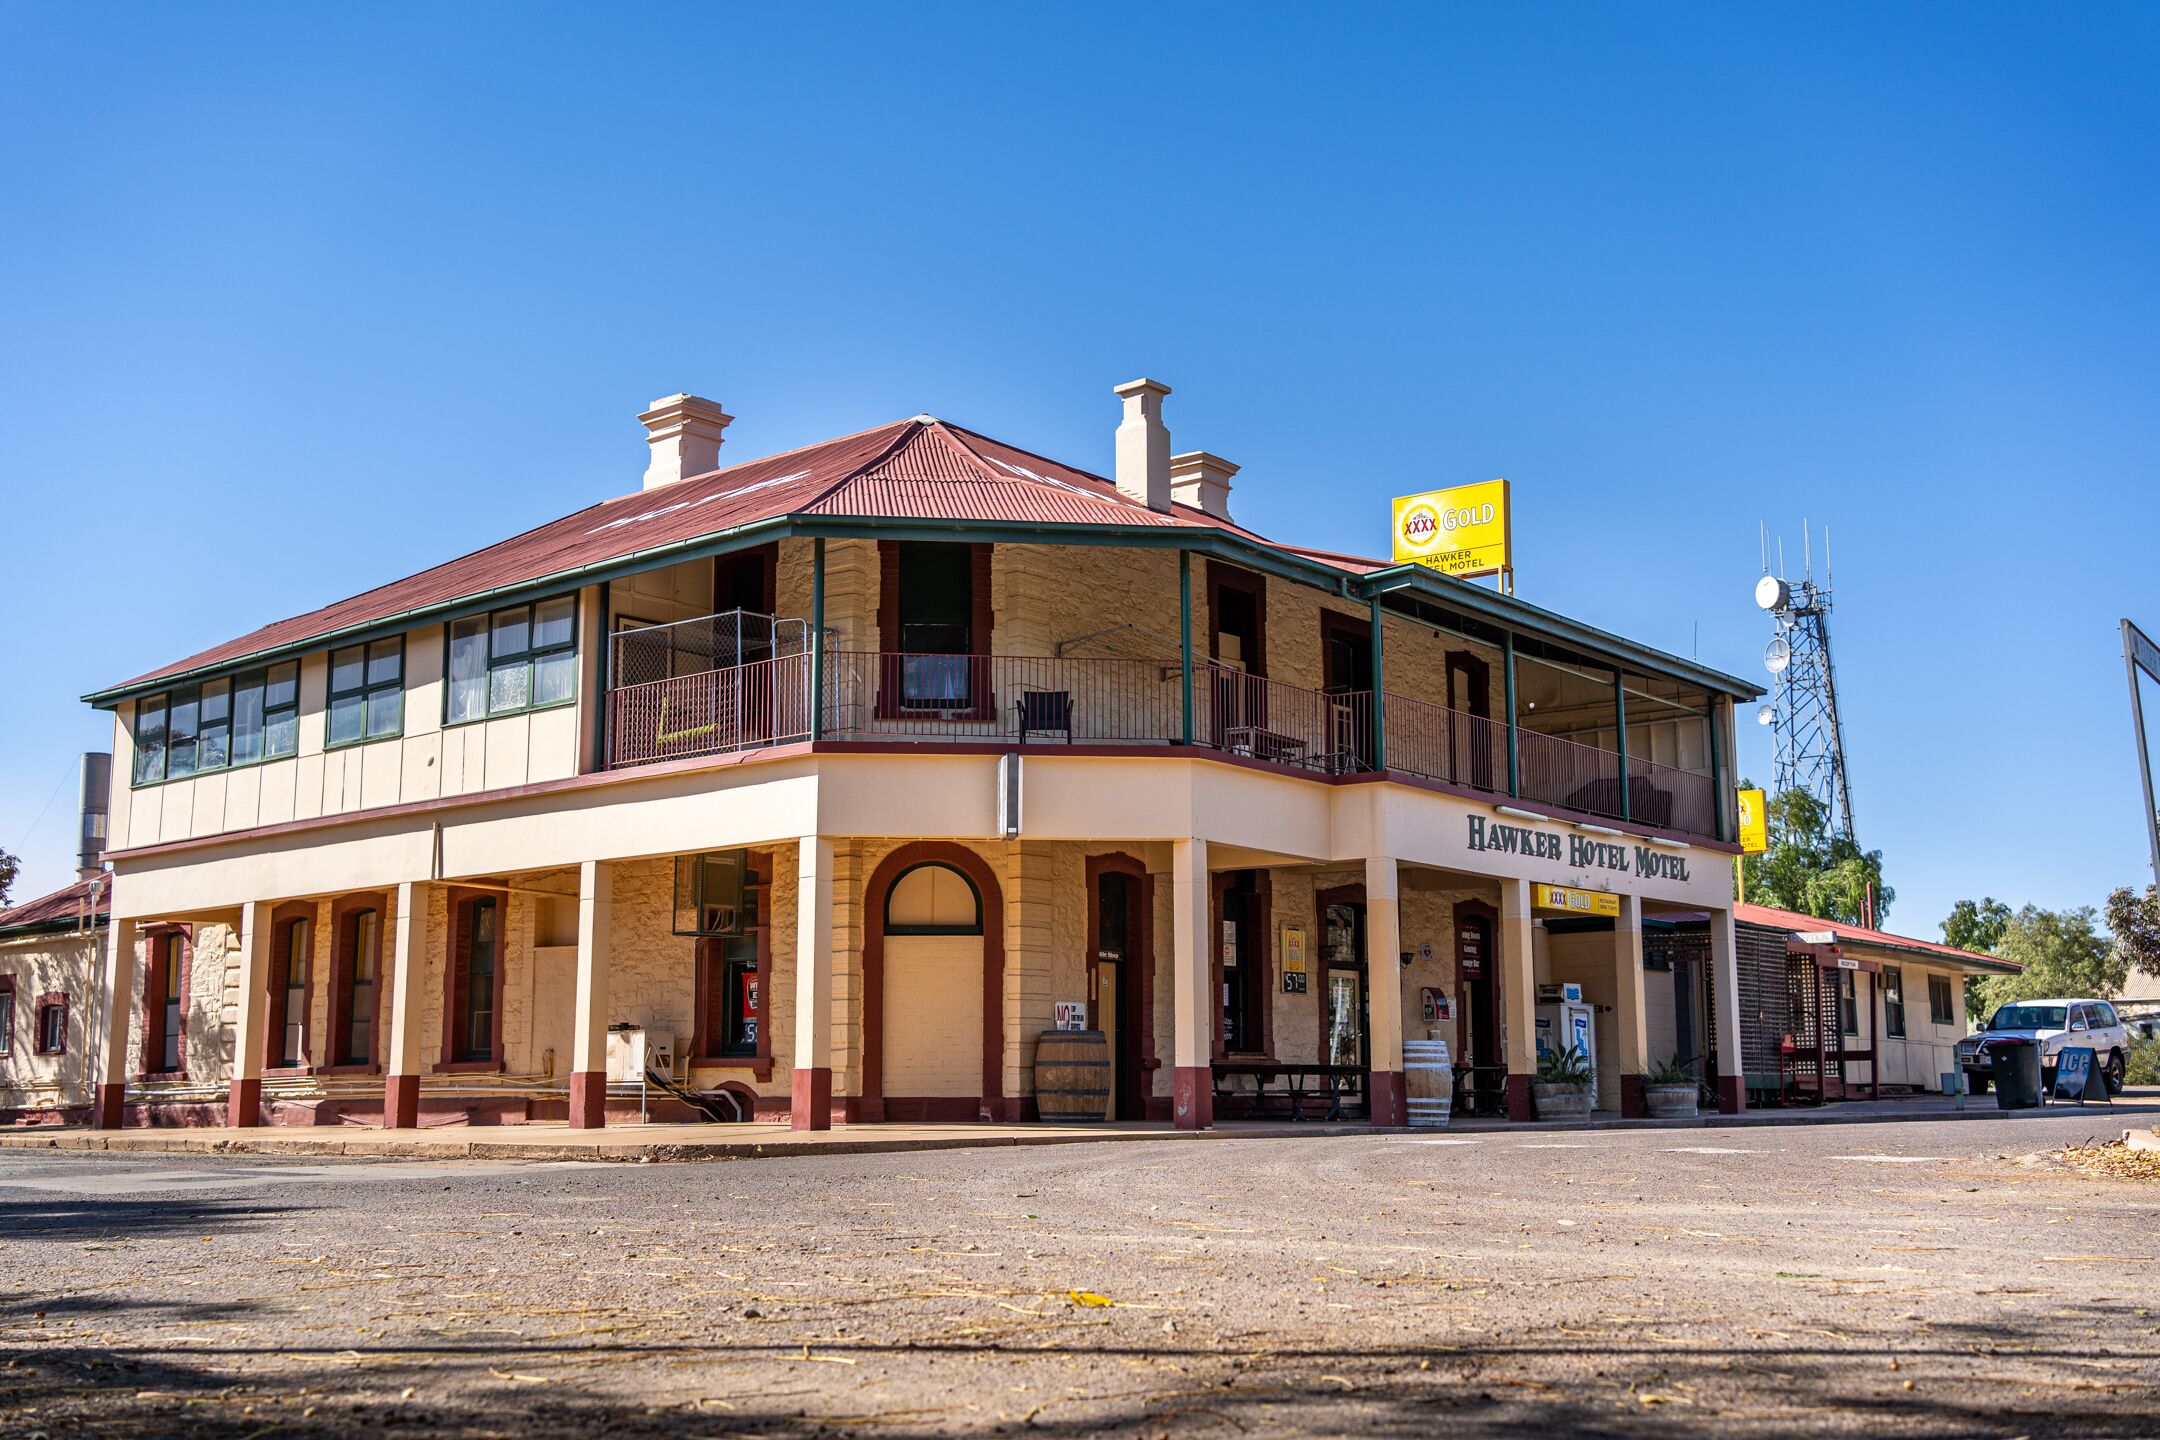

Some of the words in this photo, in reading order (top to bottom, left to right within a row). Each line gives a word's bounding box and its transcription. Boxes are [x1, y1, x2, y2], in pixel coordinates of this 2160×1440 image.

[1404, 518, 1437, 535] XXXX
[1443, 503, 1495, 531] GOLD
[1425, 550, 1471, 565] HAWKER
[1449, 558, 1484, 571] MOTEL
[1467, 814, 1562, 861] HAWKER
[1568, 833, 1630, 872] HOTEL
[1634, 845, 1690, 881] MOTEL
[1549, 891, 1567, 906] XXXX
[1569, 890, 1591, 910] GOLD
[2061, 1047, 2089, 1073] ice
